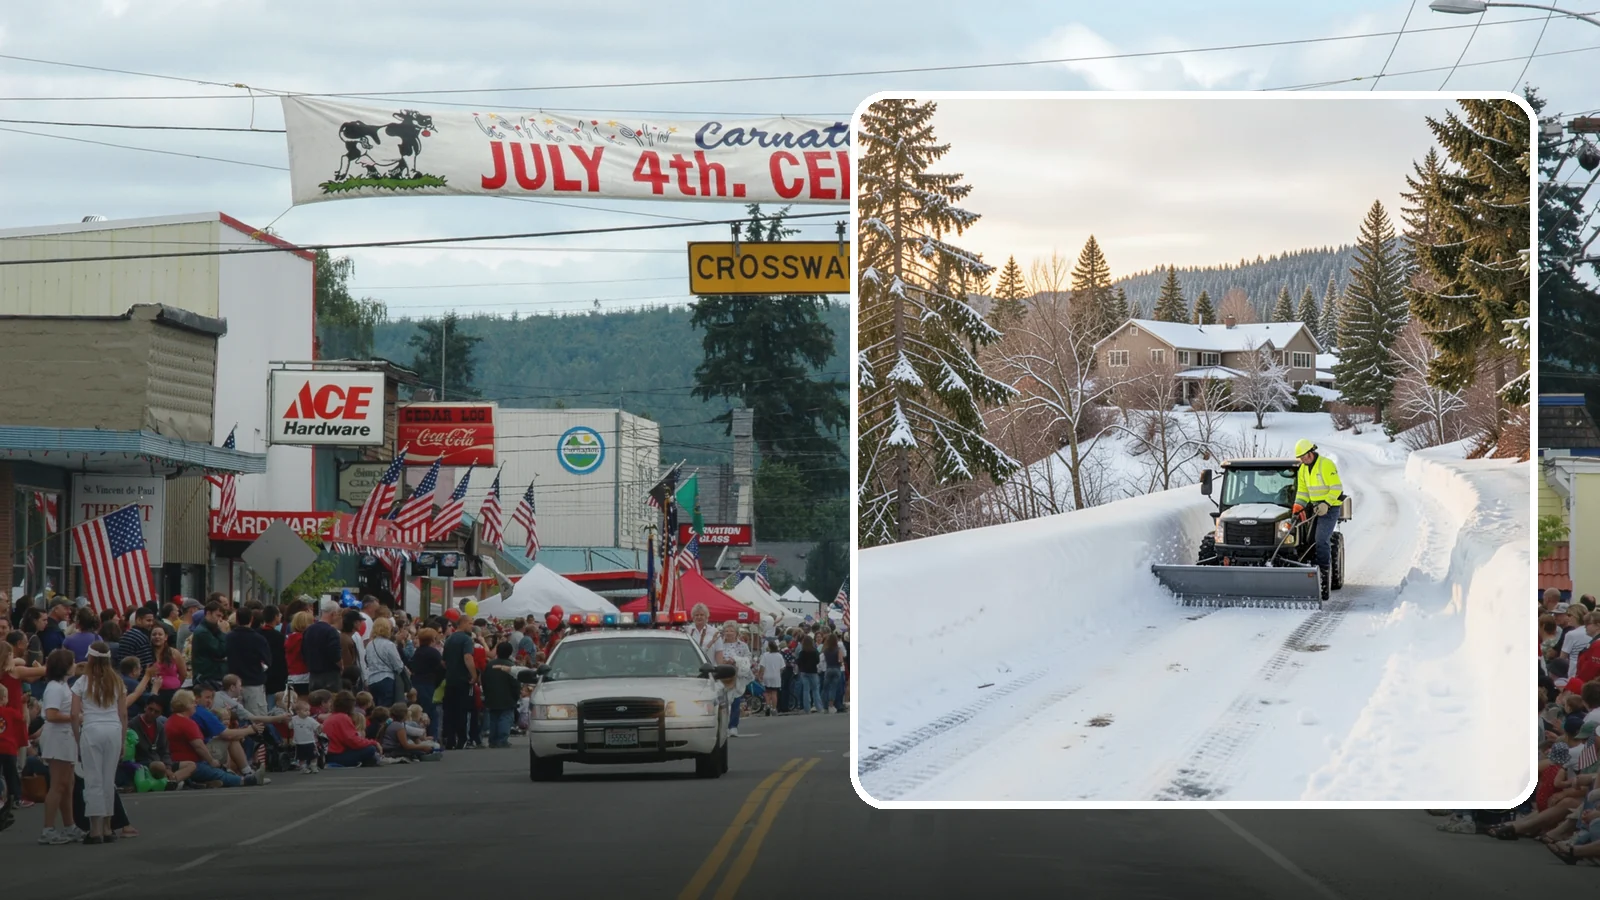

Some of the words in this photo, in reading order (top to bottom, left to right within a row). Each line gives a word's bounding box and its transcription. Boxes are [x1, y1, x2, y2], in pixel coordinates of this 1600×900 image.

[481, 140, 605, 192] JULY
[632, 149, 746, 198] 4th.
[696, 253, 850, 280] CROSSWA
[282, 379, 374, 420] ACE
[405, 409, 453, 422] CEDAR
[461, 409, 485, 422] LOG
[283, 420, 371, 437] Hardware
[416, 428, 477, 447] Coca-Cola
[353, 467, 385, 480] Simpl
[83, 484, 94, 494] St.
[95, 485, 124, 495] Vincent
[126, 486, 136, 495] de
[137, 485, 155, 495] Paul
[80, 503, 154, 522] THT
[212, 516, 331, 536] HARDARE
[688, 526, 742, 535] CRNATION
[699, 535, 730, 543] GLASS
